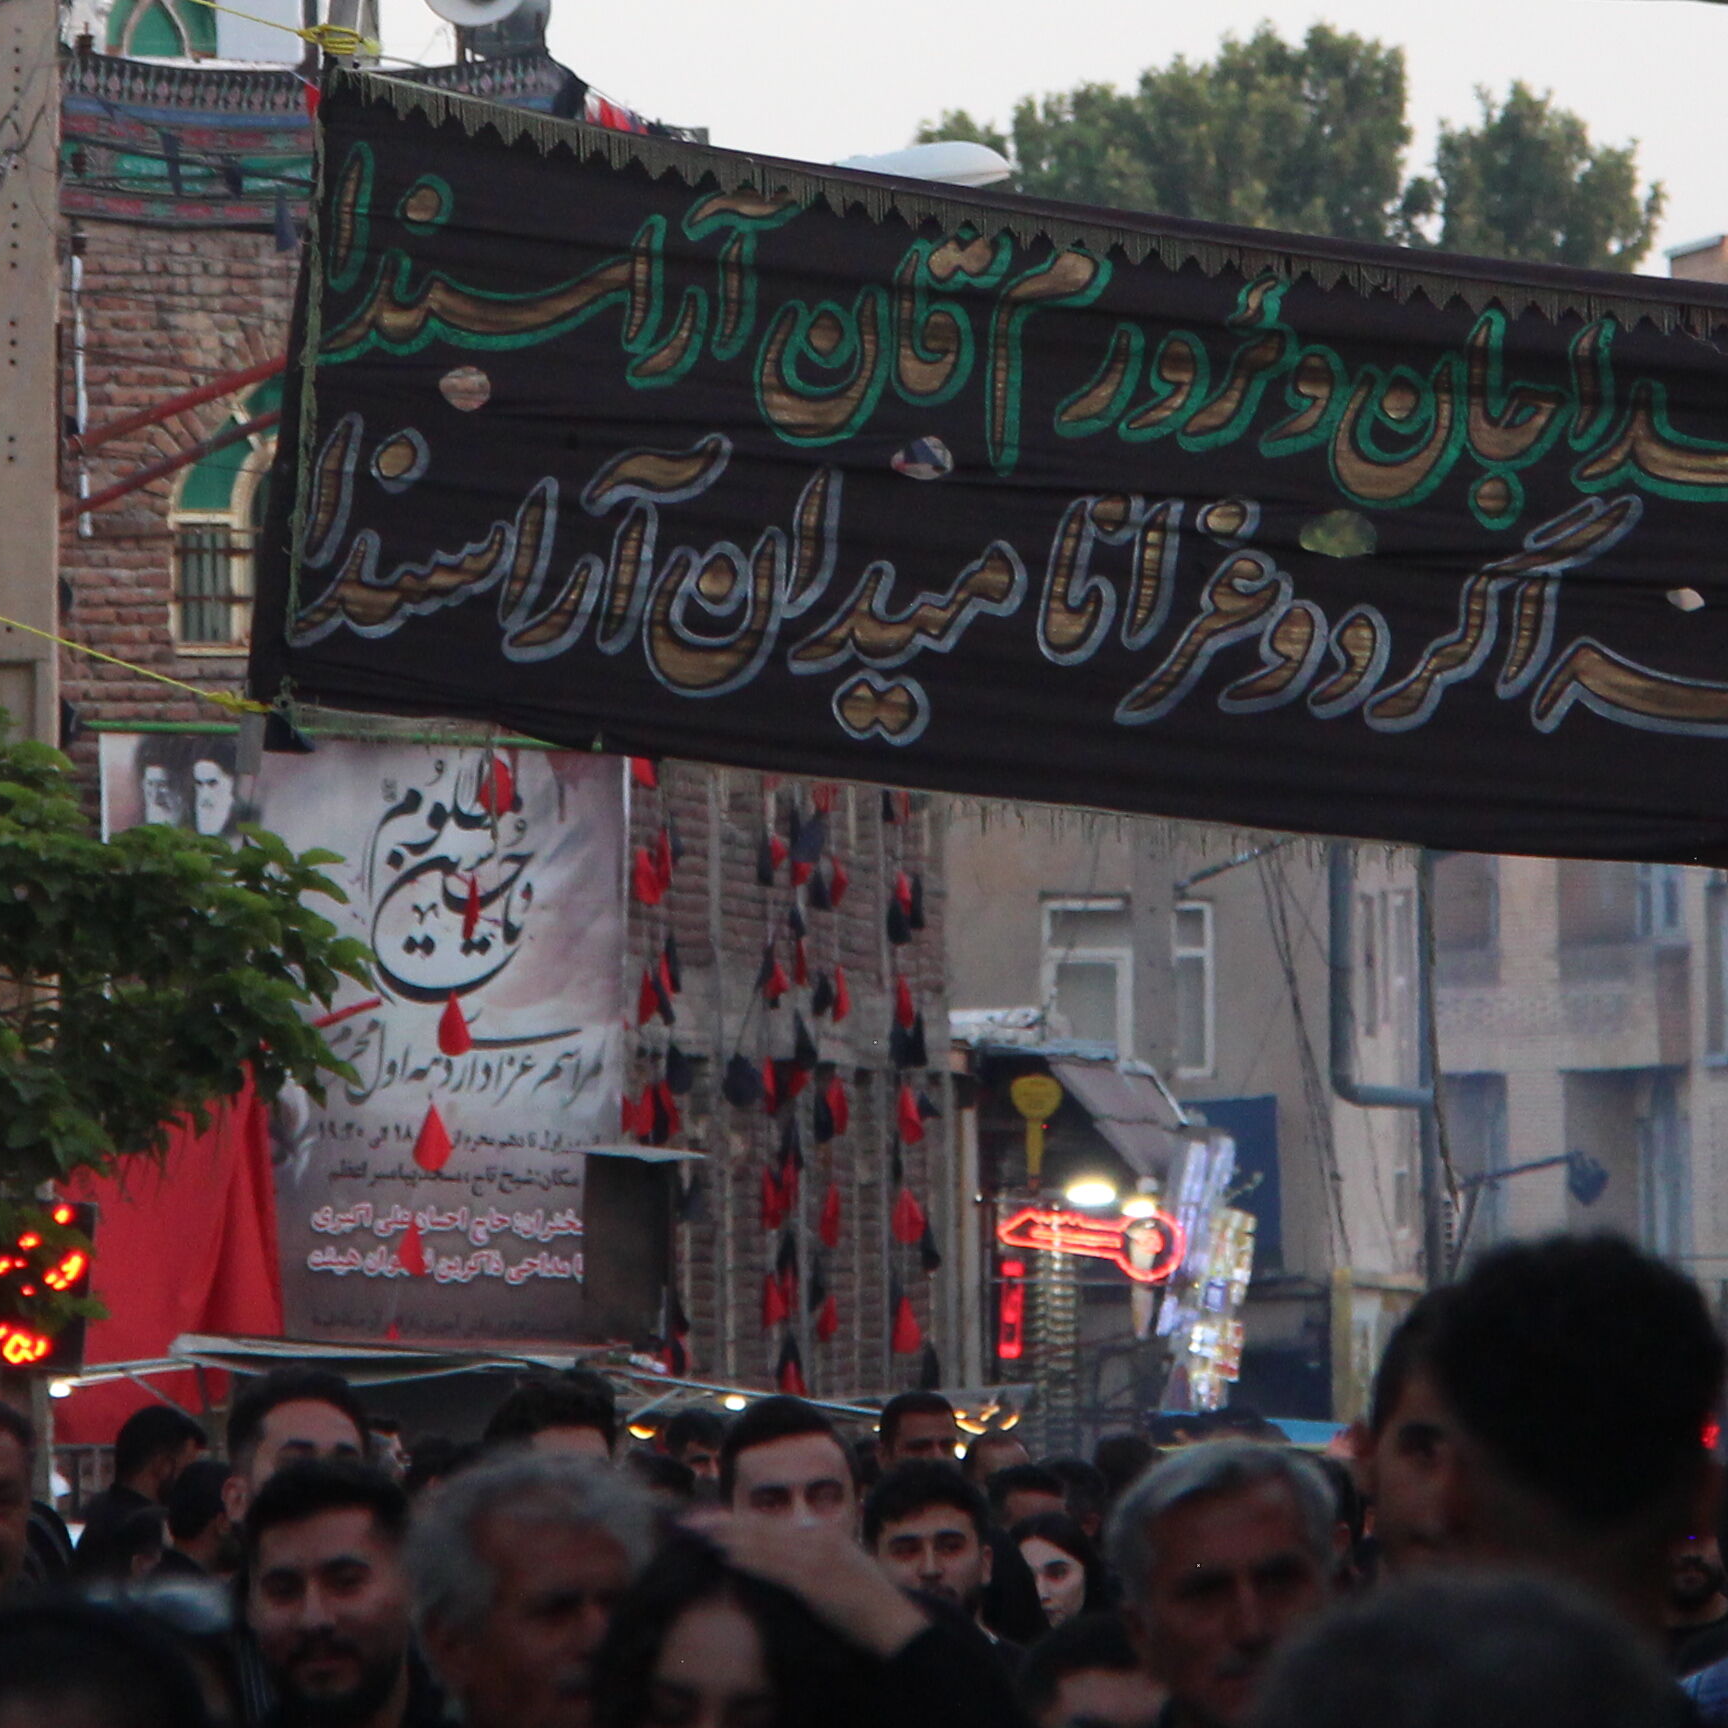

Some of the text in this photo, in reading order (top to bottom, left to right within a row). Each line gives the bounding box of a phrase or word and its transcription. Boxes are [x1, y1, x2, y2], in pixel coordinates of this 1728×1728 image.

[1329, 307, 1569, 532] جان
[644, 465, 1026, 746] میدان
[532, 1039, 606, 1107] مراسم
